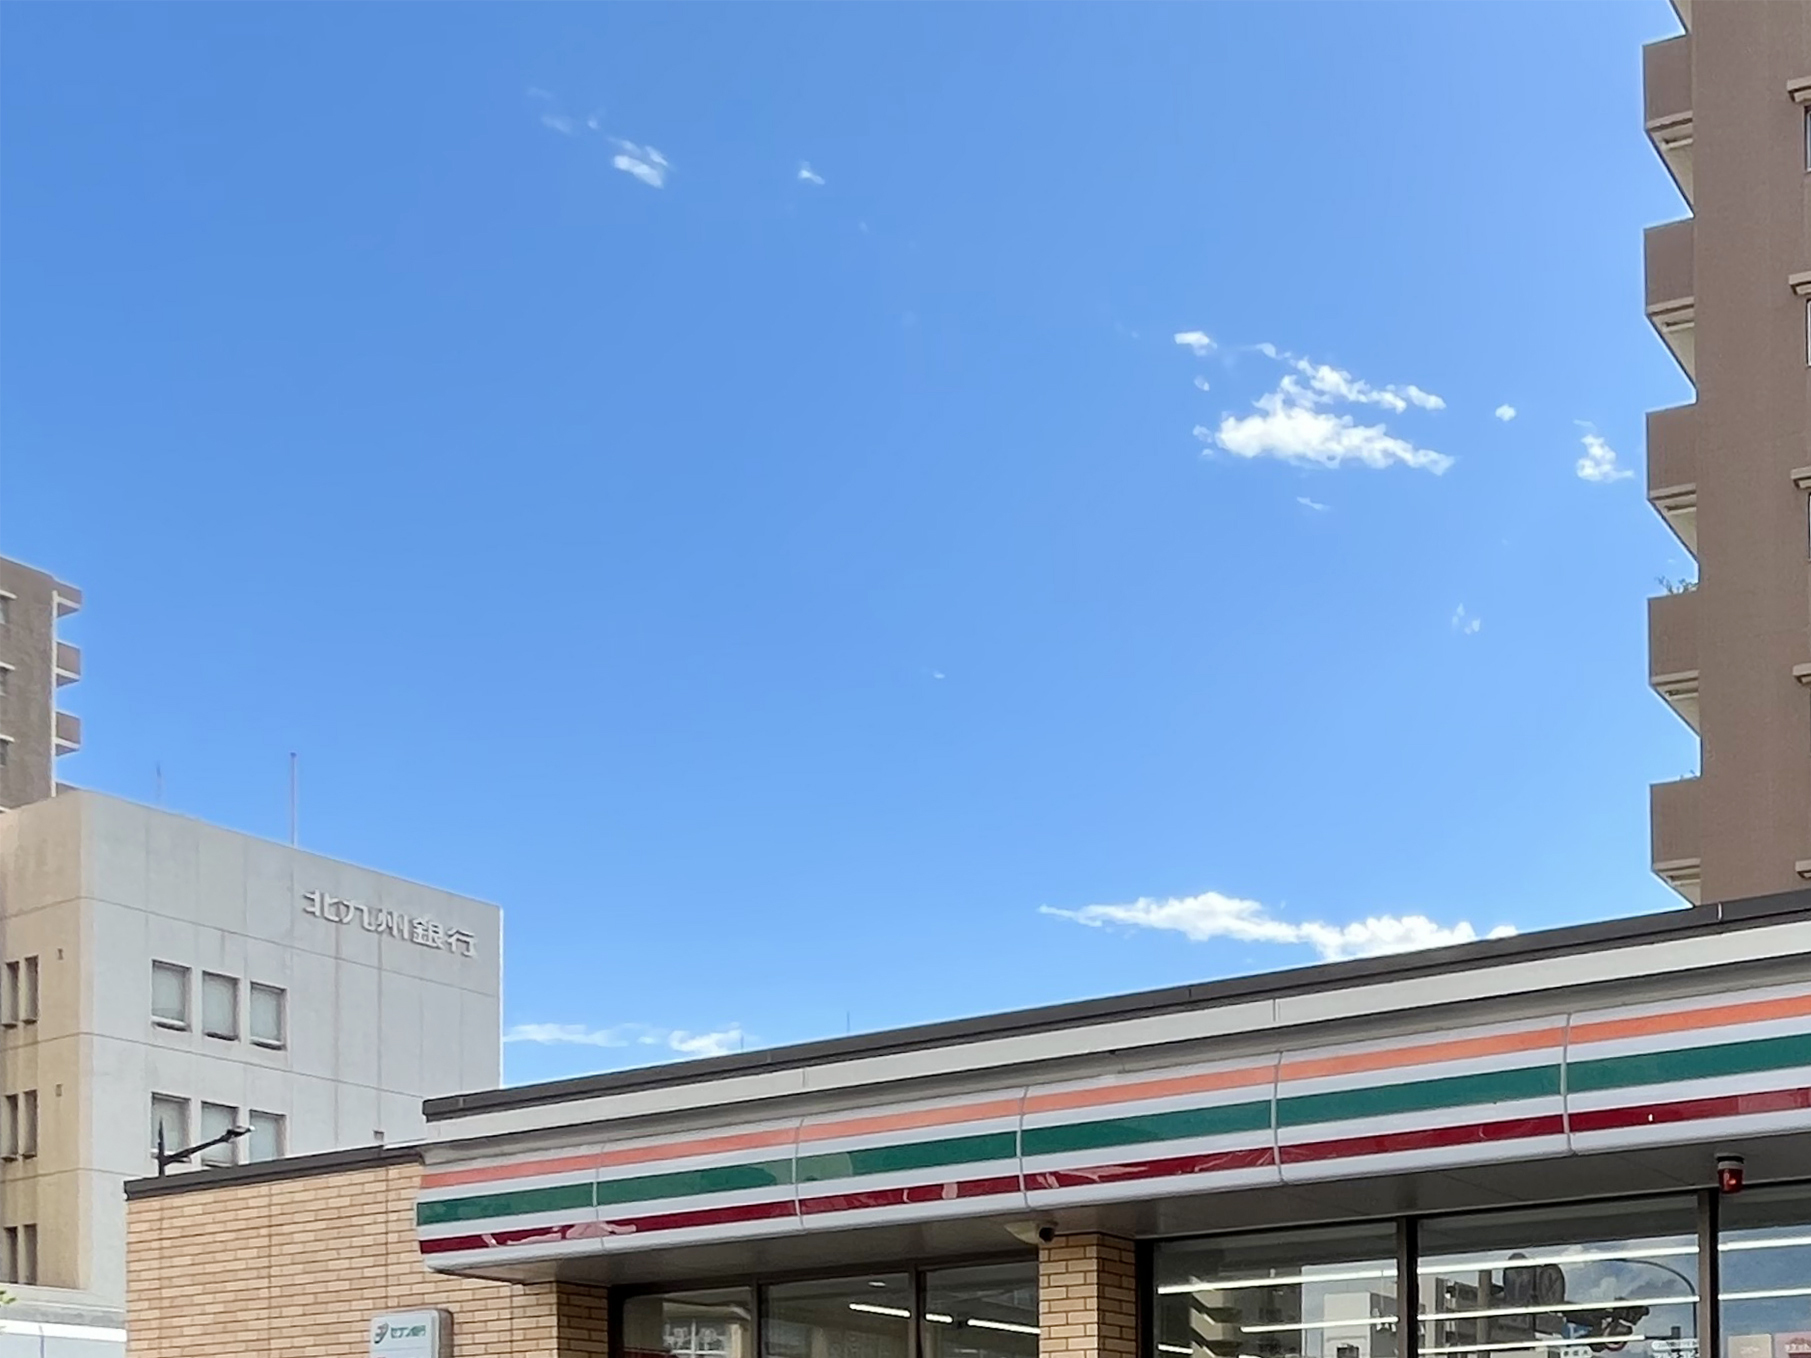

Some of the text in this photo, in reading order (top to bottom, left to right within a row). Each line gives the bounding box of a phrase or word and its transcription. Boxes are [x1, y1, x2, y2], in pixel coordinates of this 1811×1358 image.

[303, 889, 478, 959] 北九州銀行
